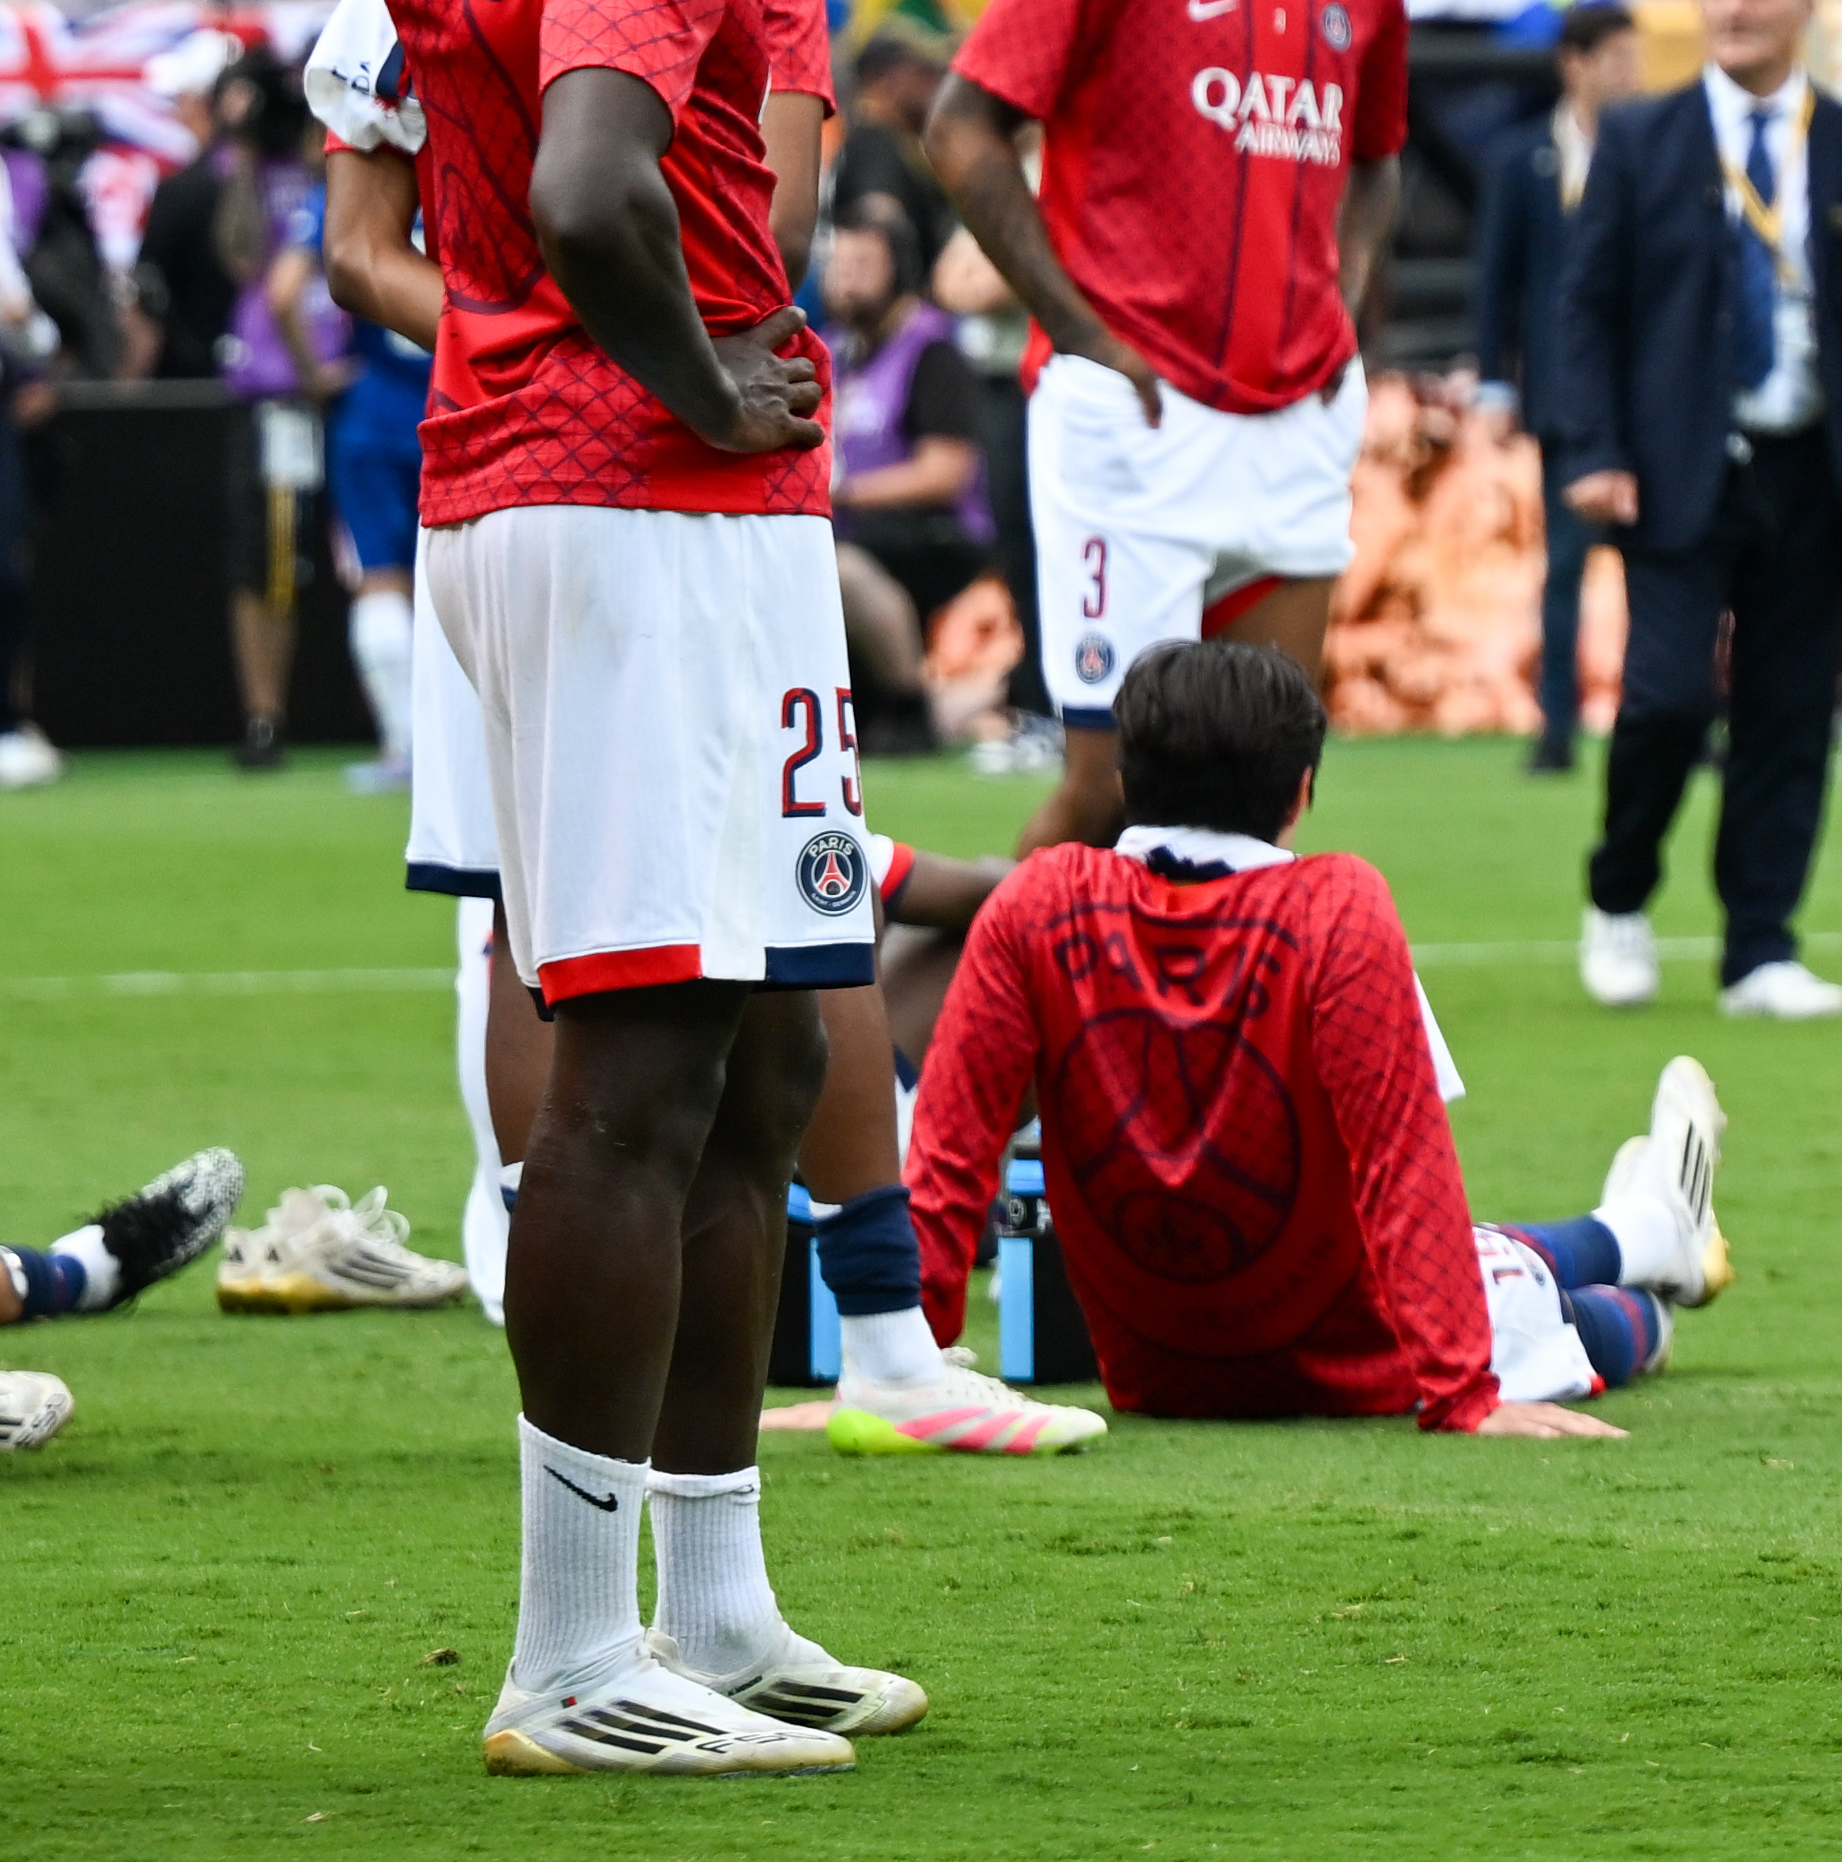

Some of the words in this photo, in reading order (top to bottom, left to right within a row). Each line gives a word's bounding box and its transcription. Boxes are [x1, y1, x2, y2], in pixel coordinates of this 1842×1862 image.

[1191, 66, 1344, 134] QATAR
[1234, 121, 1342, 169] AIRWAYS
[1083, 536, 1107, 619] 3
[780, 686, 863, 818] 25
[808, 836, 855, 858] PARIS
